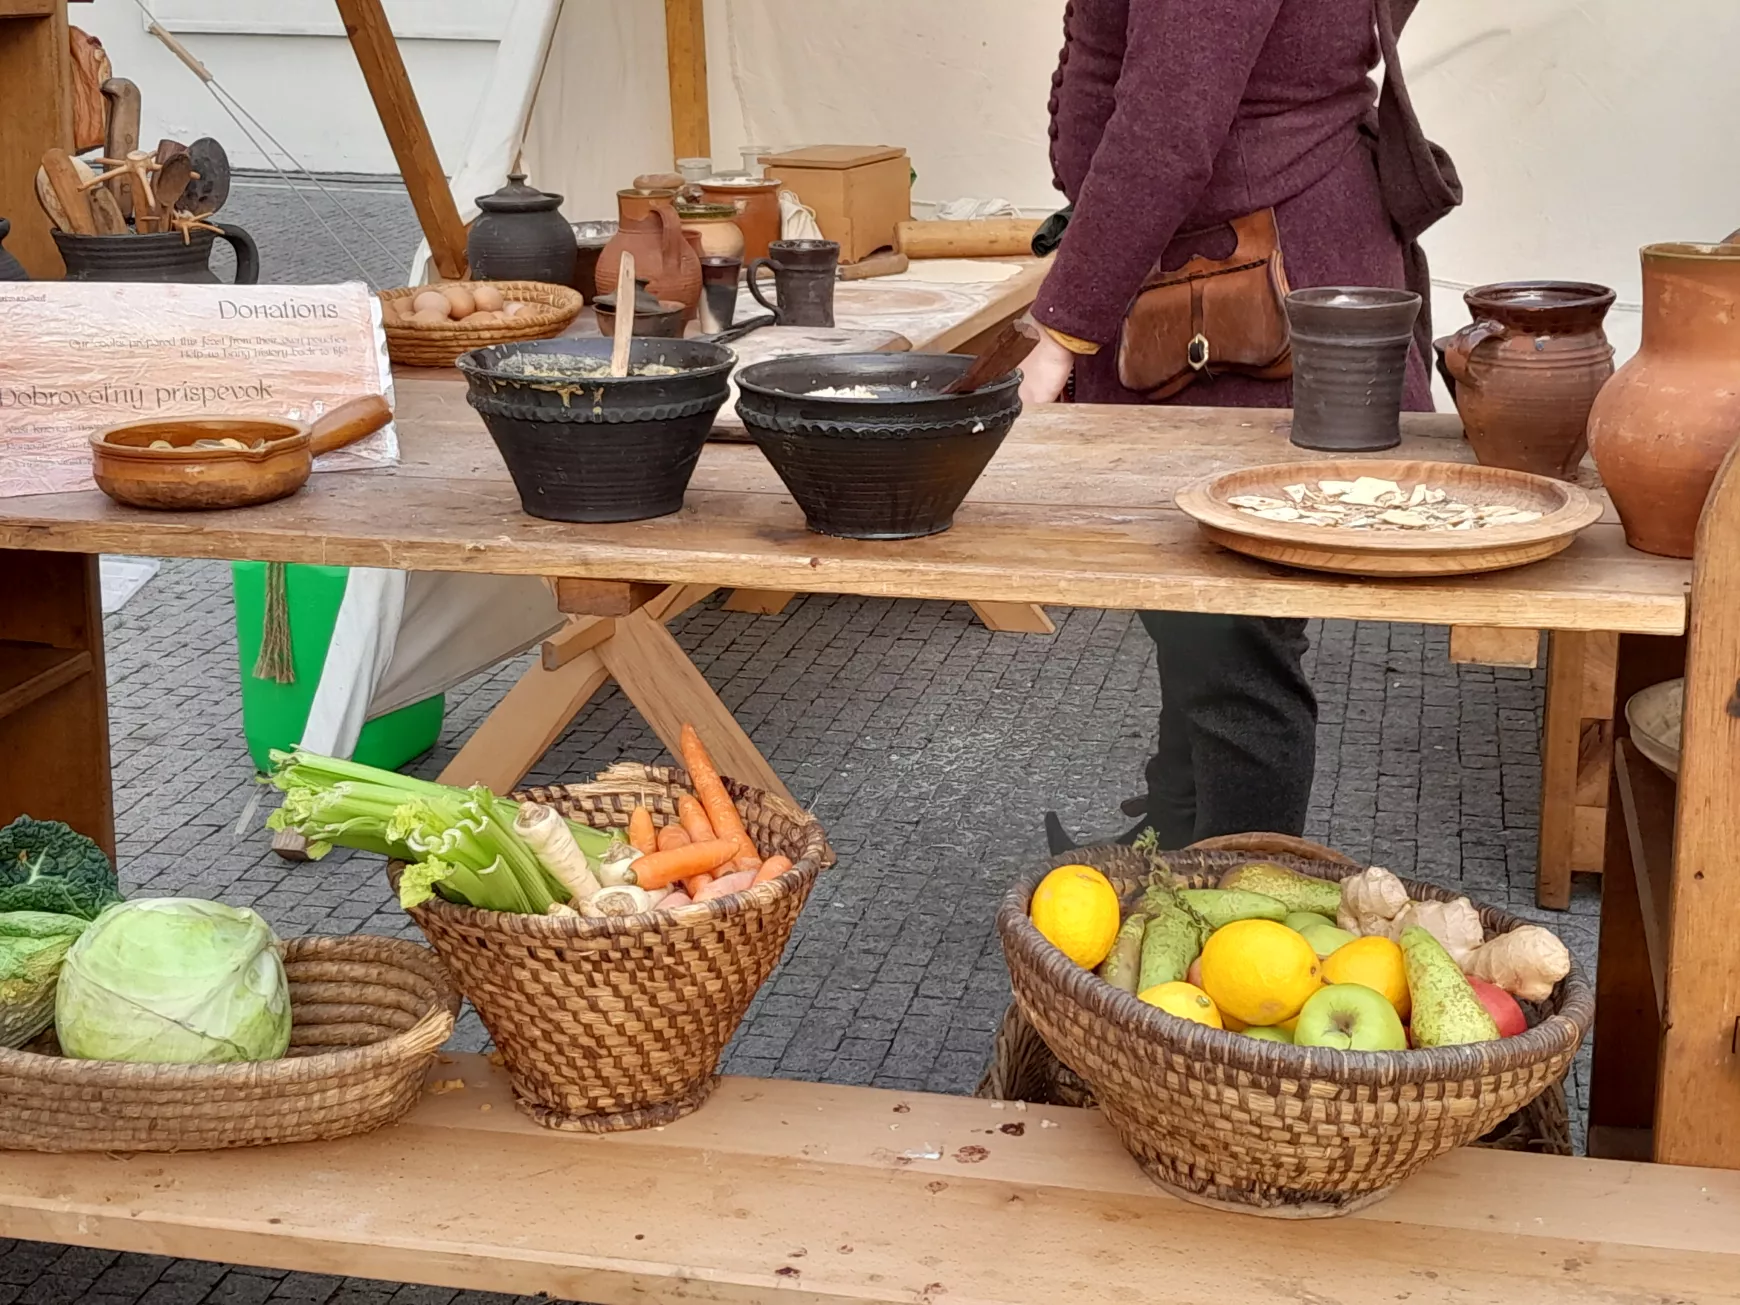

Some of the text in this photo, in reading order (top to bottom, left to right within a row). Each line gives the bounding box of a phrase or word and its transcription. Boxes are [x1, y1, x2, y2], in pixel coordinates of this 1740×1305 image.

[218, 298, 338, 319] Donations
[230, 335, 252, 347] from
[255, 348, 288, 359] history
[0, 380, 274, 409] Dobrovoľný príspevok
